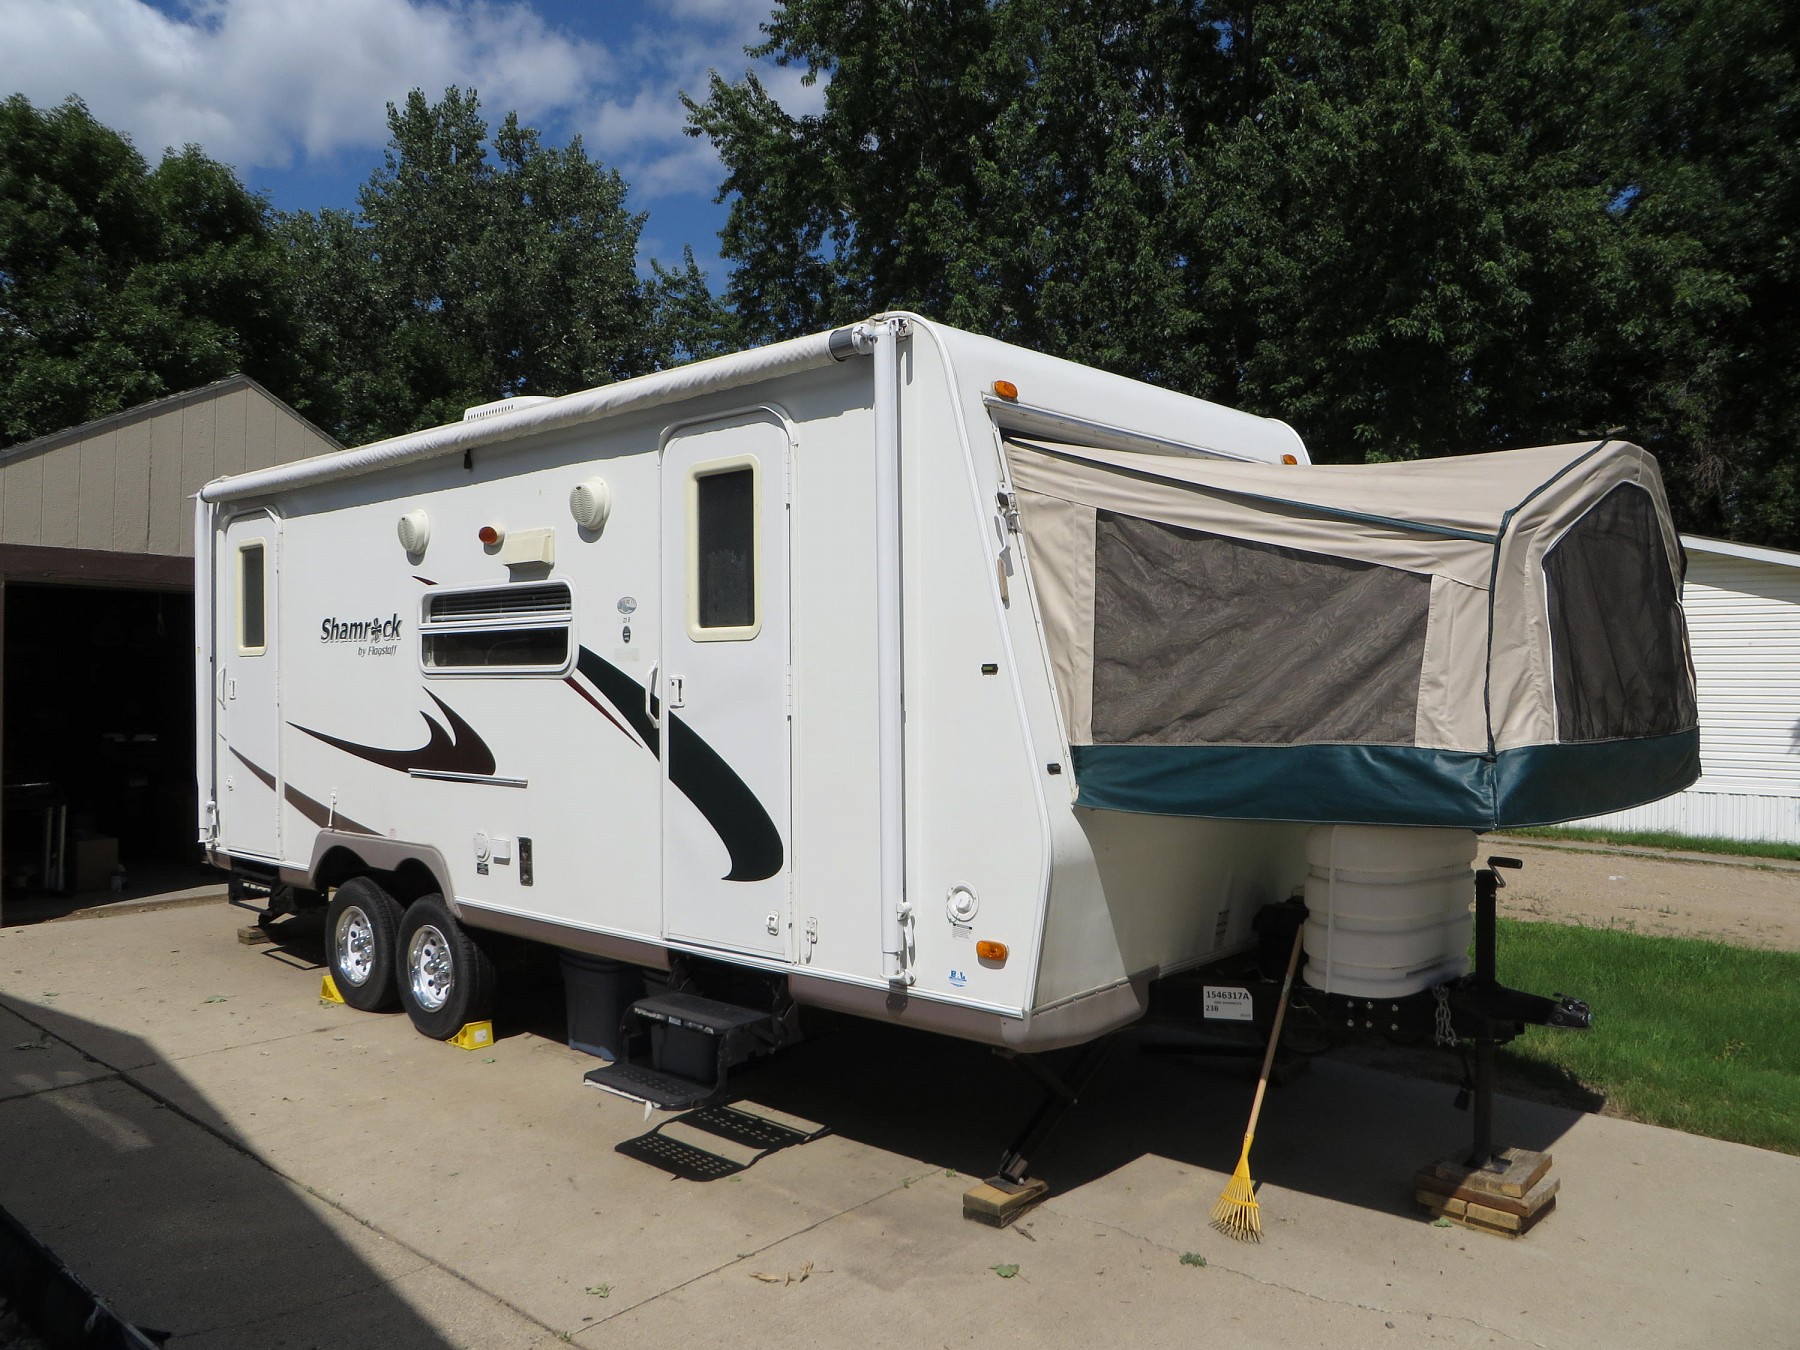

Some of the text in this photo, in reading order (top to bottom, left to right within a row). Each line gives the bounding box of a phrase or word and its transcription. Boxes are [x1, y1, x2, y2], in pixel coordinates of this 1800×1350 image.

[358, 645, 397, 657] by Flagstaff
[1206, 990, 1250, 1000] 1546317A
